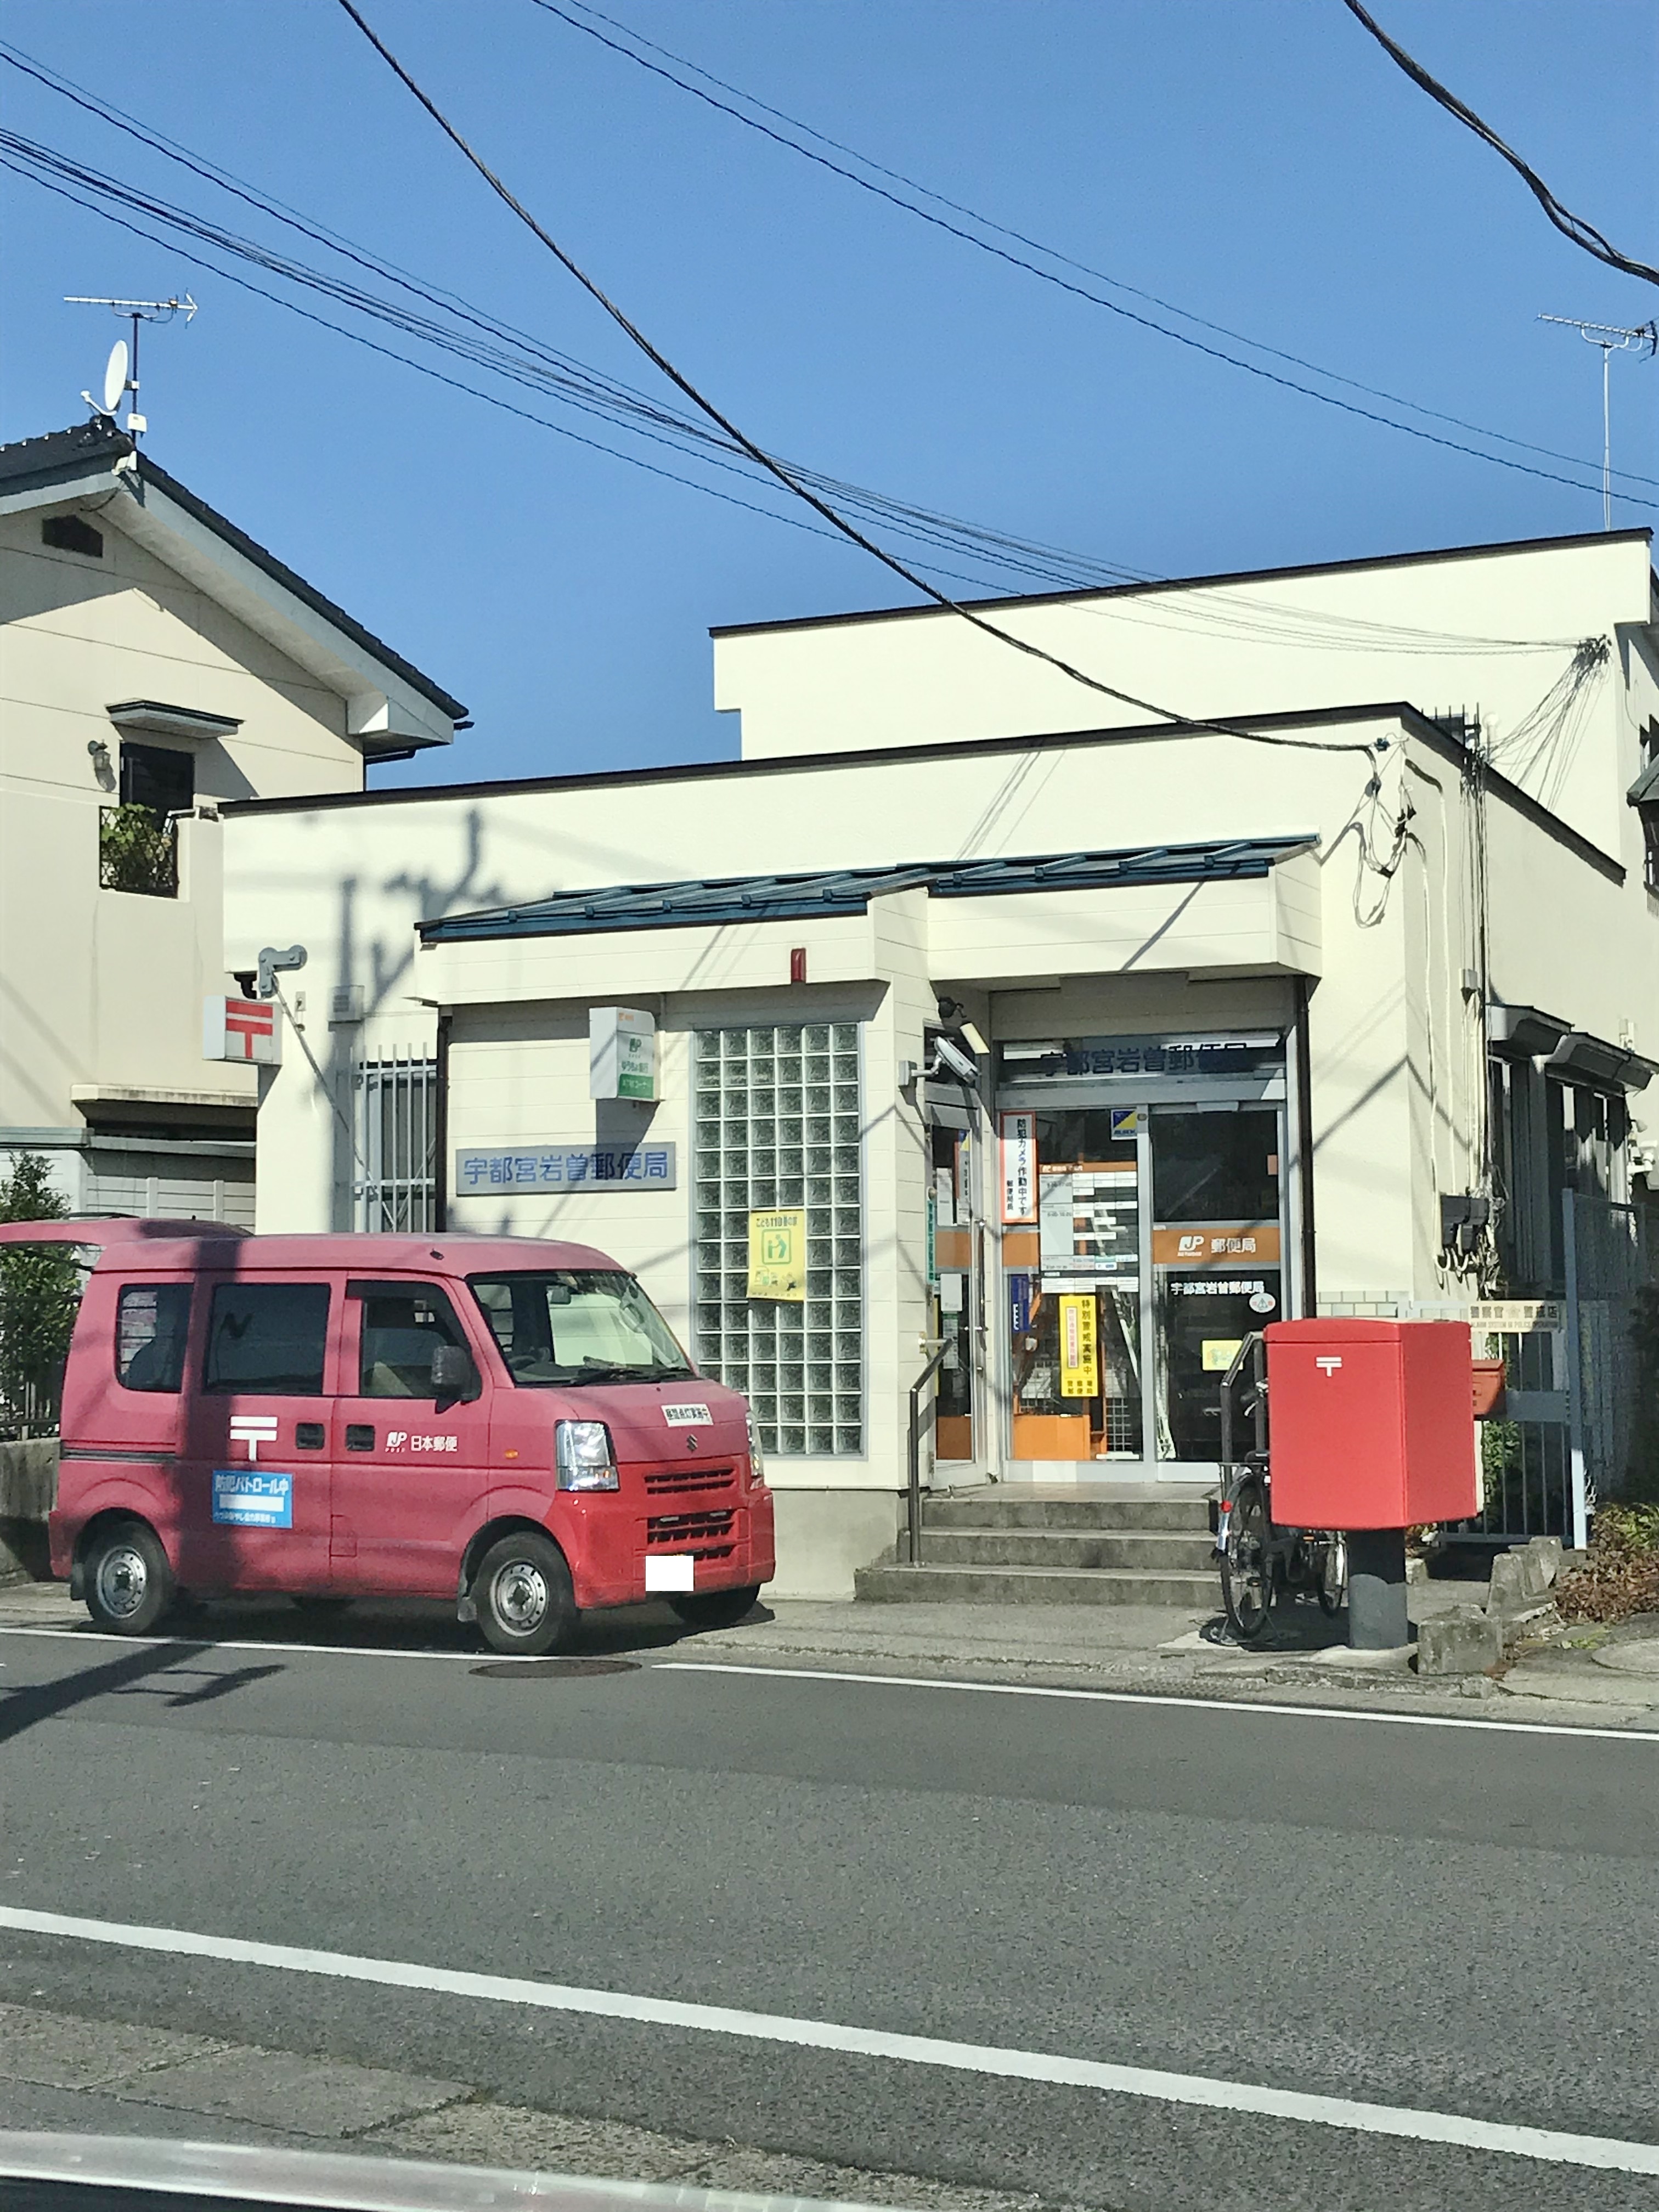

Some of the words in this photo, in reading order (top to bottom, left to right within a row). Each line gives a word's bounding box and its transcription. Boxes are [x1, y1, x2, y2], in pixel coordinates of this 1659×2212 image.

[1041, 1042, 1246, 1077] 宇都宮岩曽郵
[464, 1152, 668, 1185] 宇都宮岩曽郵便局
[1017, 1119, 1028, 1215] 防犯カメラ作動中です
[1211, 1238, 1256, 1253] 郵便局
[1170, 1281, 1265, 1295] 宇都宮岩曽郵便局
[411, 1435, 458, 1452] 日本郵便
[215, 1474, 289, 1496] 防犯パトロール中
